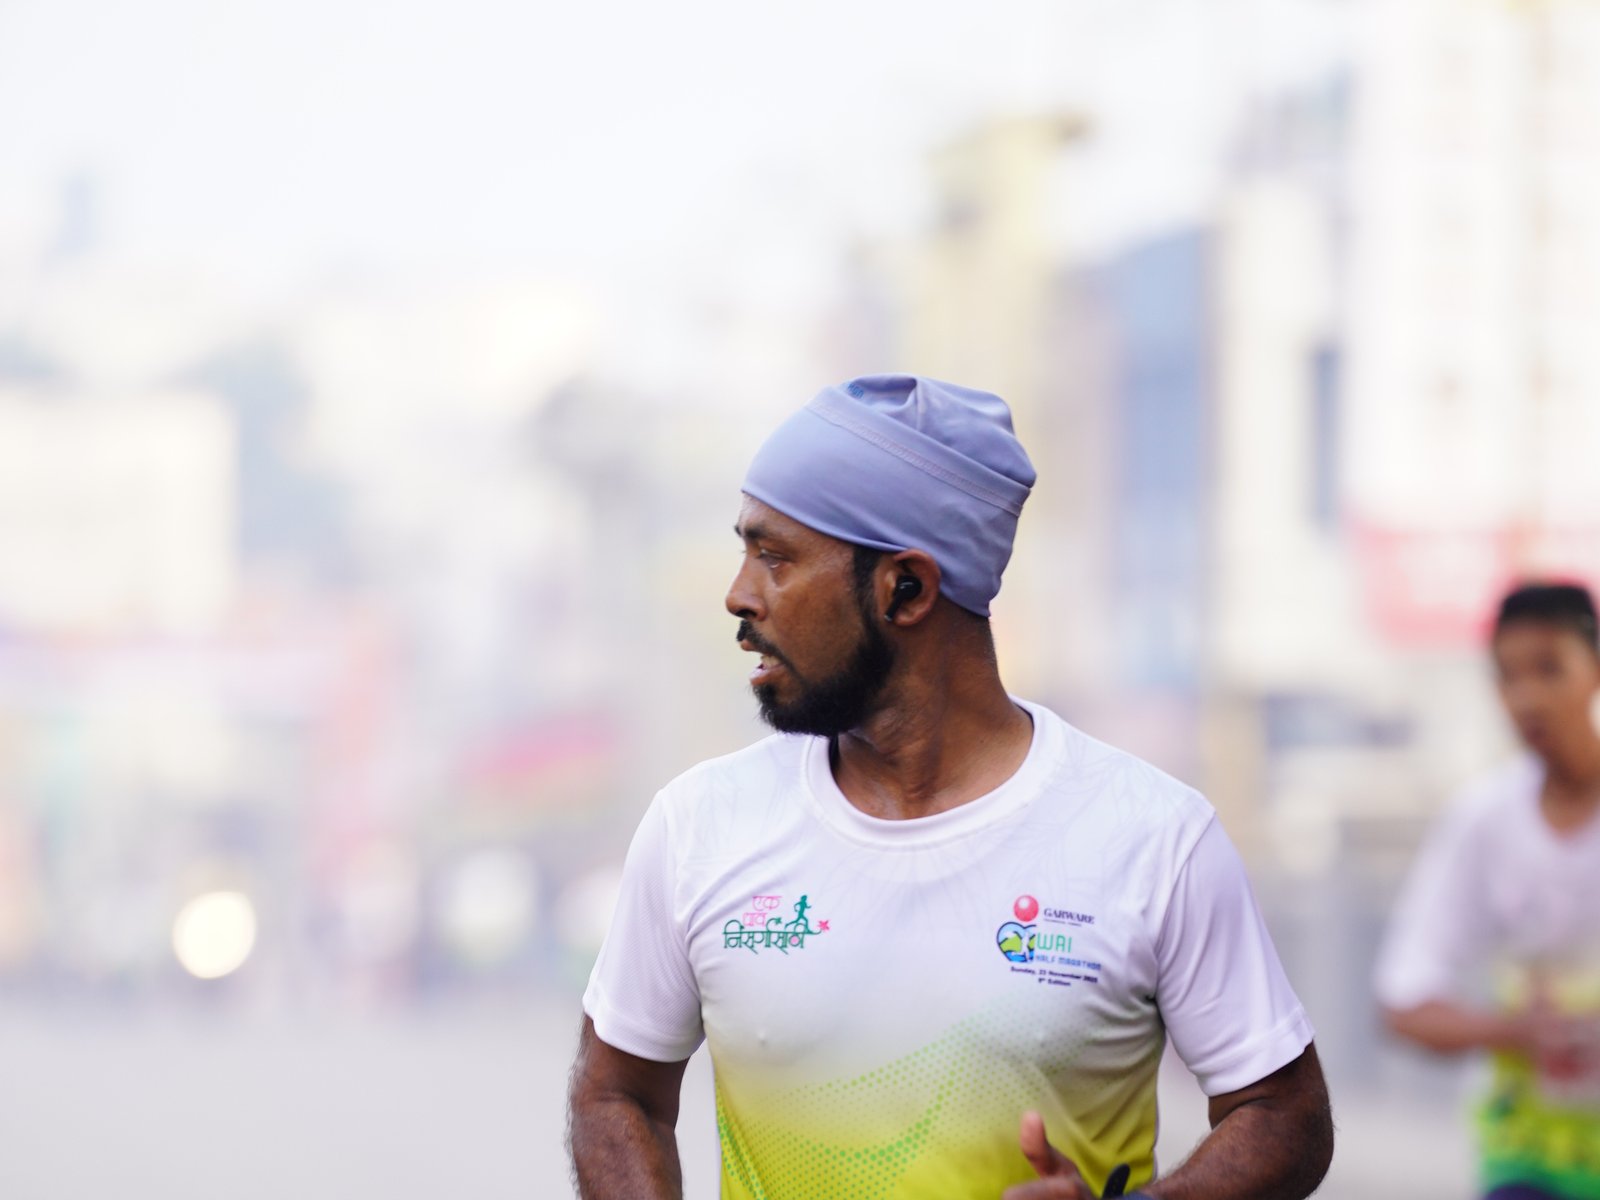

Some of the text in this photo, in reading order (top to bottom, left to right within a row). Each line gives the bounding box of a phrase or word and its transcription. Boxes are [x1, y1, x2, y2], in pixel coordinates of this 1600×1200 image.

[752, 895, 783, 911] एक
[1043, 907, 1095, 925] GARWARE
[1036, 932, 1073, 953] WAI
[1058, 956, 1102, 972] MARATHON
